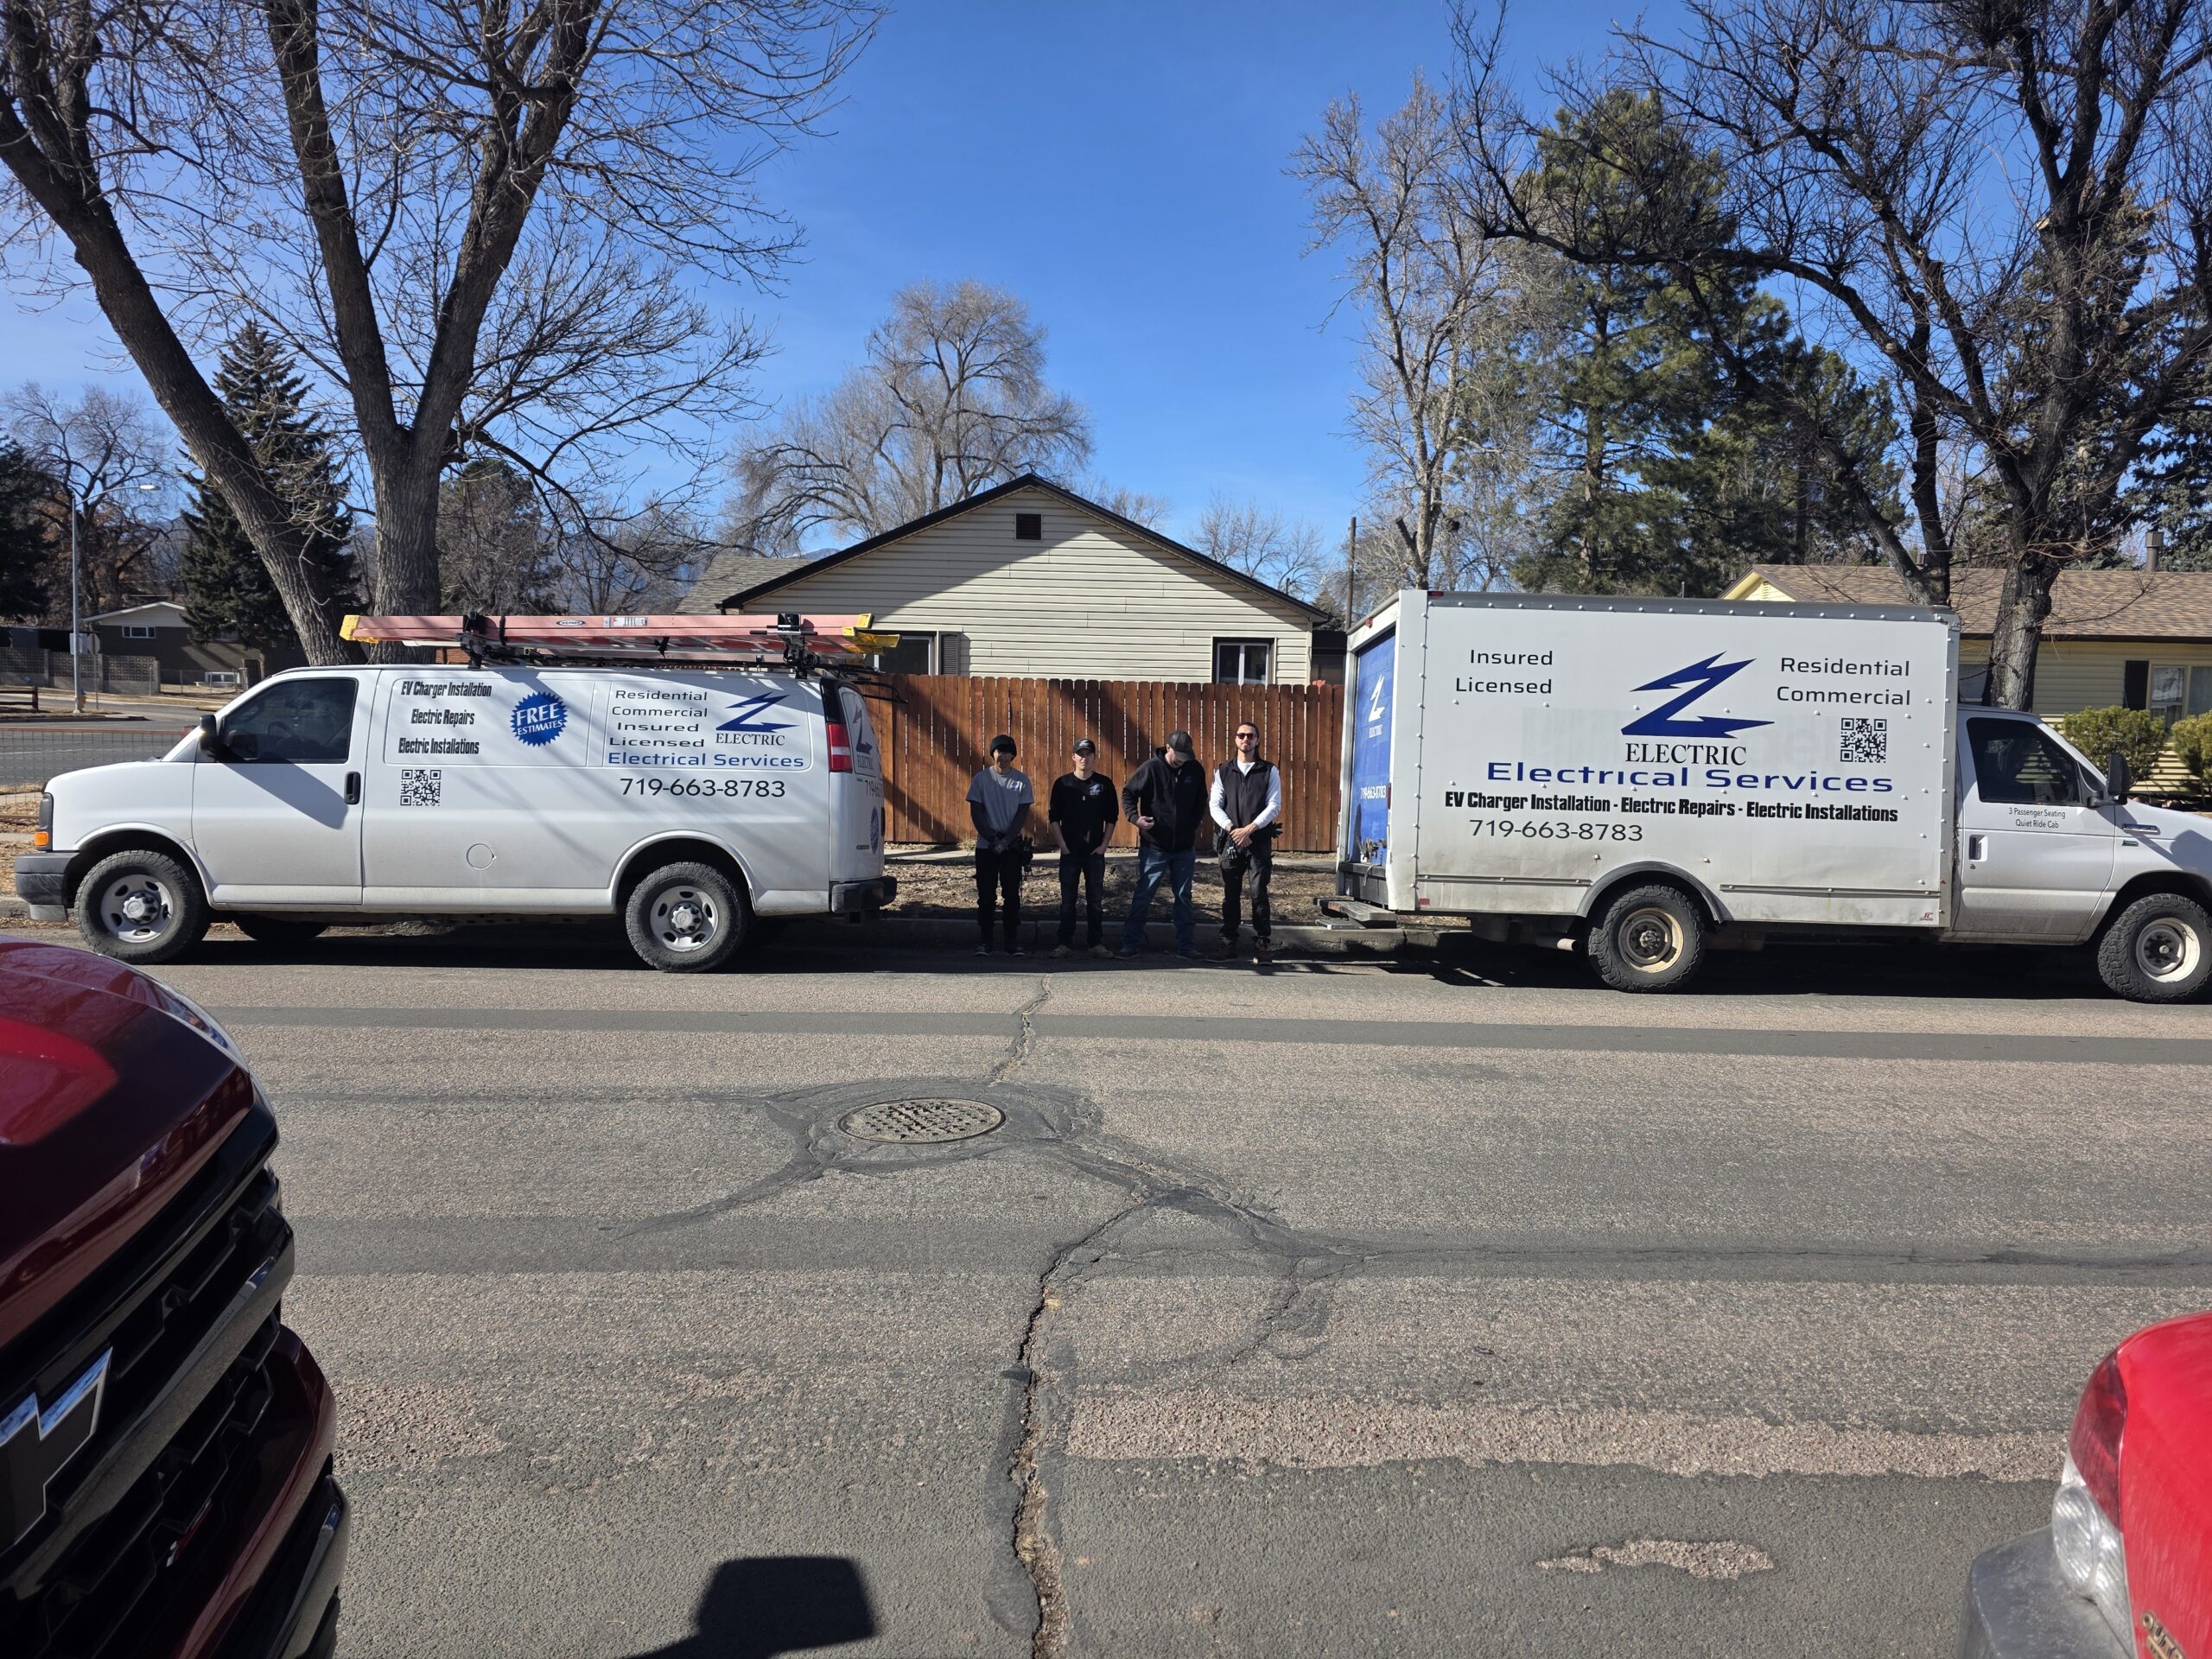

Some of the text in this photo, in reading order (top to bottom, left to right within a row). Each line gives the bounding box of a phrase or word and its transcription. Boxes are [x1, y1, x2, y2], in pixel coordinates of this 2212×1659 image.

[1470, 649, 1553, 665] Insured
[1780, 658, 1910, 677] Residential
[401, 681, 493, 698] EV Charger Installation
[1455, 677, 1552, 694] Licensed
[615, 690, 708, 701] Residential
[1777, 686, 1910, 705] Commercial
[411, 709, 474, 728] Electric Repairs
[516, 702, 561, 727] FREE
[612, 706, 708, 717] Commercial
[517, 719, 563, 735] ESTIMATES
[617, 722, 699, 732] Insured
[398, 737, 480, 754] Electric Installations
[609, 737, 705, 747] Licensed
[715, 733, 785, 746] ELECTRIC
[607, 751, 804, 767] Electrical Services
[1625, 742, 1747, 766] ELECTRIC
[1487, 761, 1893, 792] Electrical Services
[620, 778, 785, 797] 719-663-8783
[1445, 791, 1465, 807] EV
[1467, 791, 1529, 811] Charger
[1530, 794, 1611, 812] Installation
[1621, 797, 1676, 814] Electric
[1678, 798, 1736, 817] Repairs
[1746, 801, 1802, 819] Electric
[1805, 803, 1899, 822] Installations
[2014, 807, 2044, 818] Passenger
[2044, 809, 2066, 819] Seating
[1469, 819, 1643, 842] 719-663-8783
[2015, 818, 2059, 829] Quiet Ride Cab
